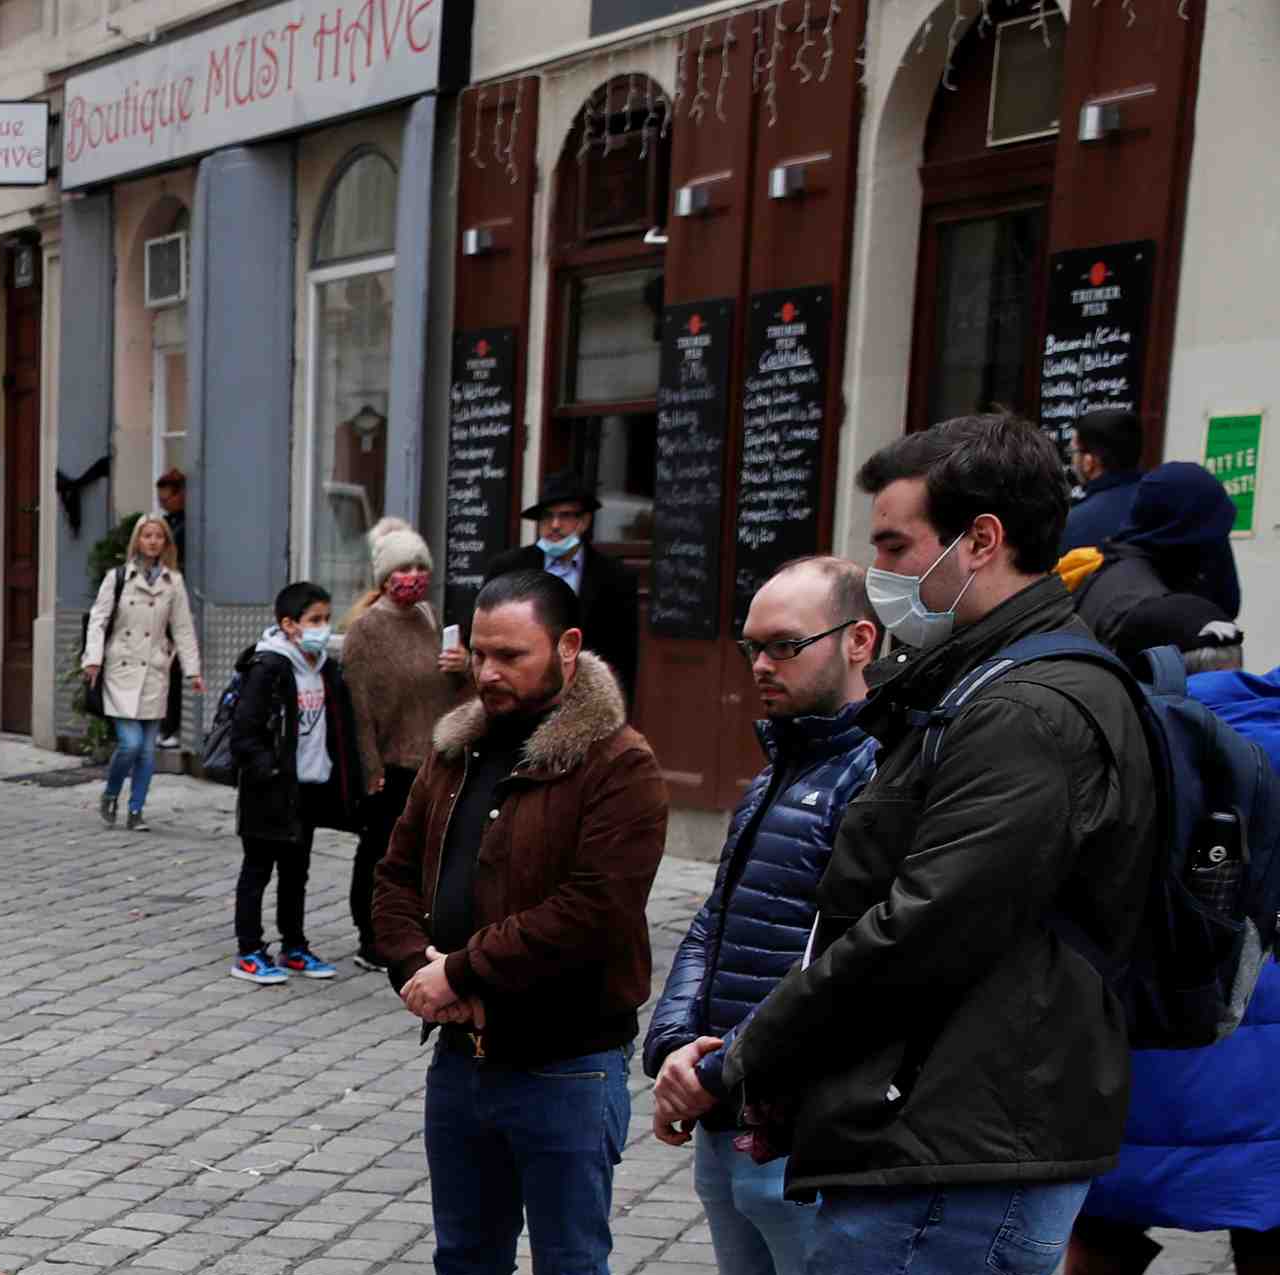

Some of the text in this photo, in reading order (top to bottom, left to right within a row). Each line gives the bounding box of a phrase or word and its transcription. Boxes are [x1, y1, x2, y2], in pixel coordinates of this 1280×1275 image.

[66, 0, 434, 162] Boutique MUST HAVE
